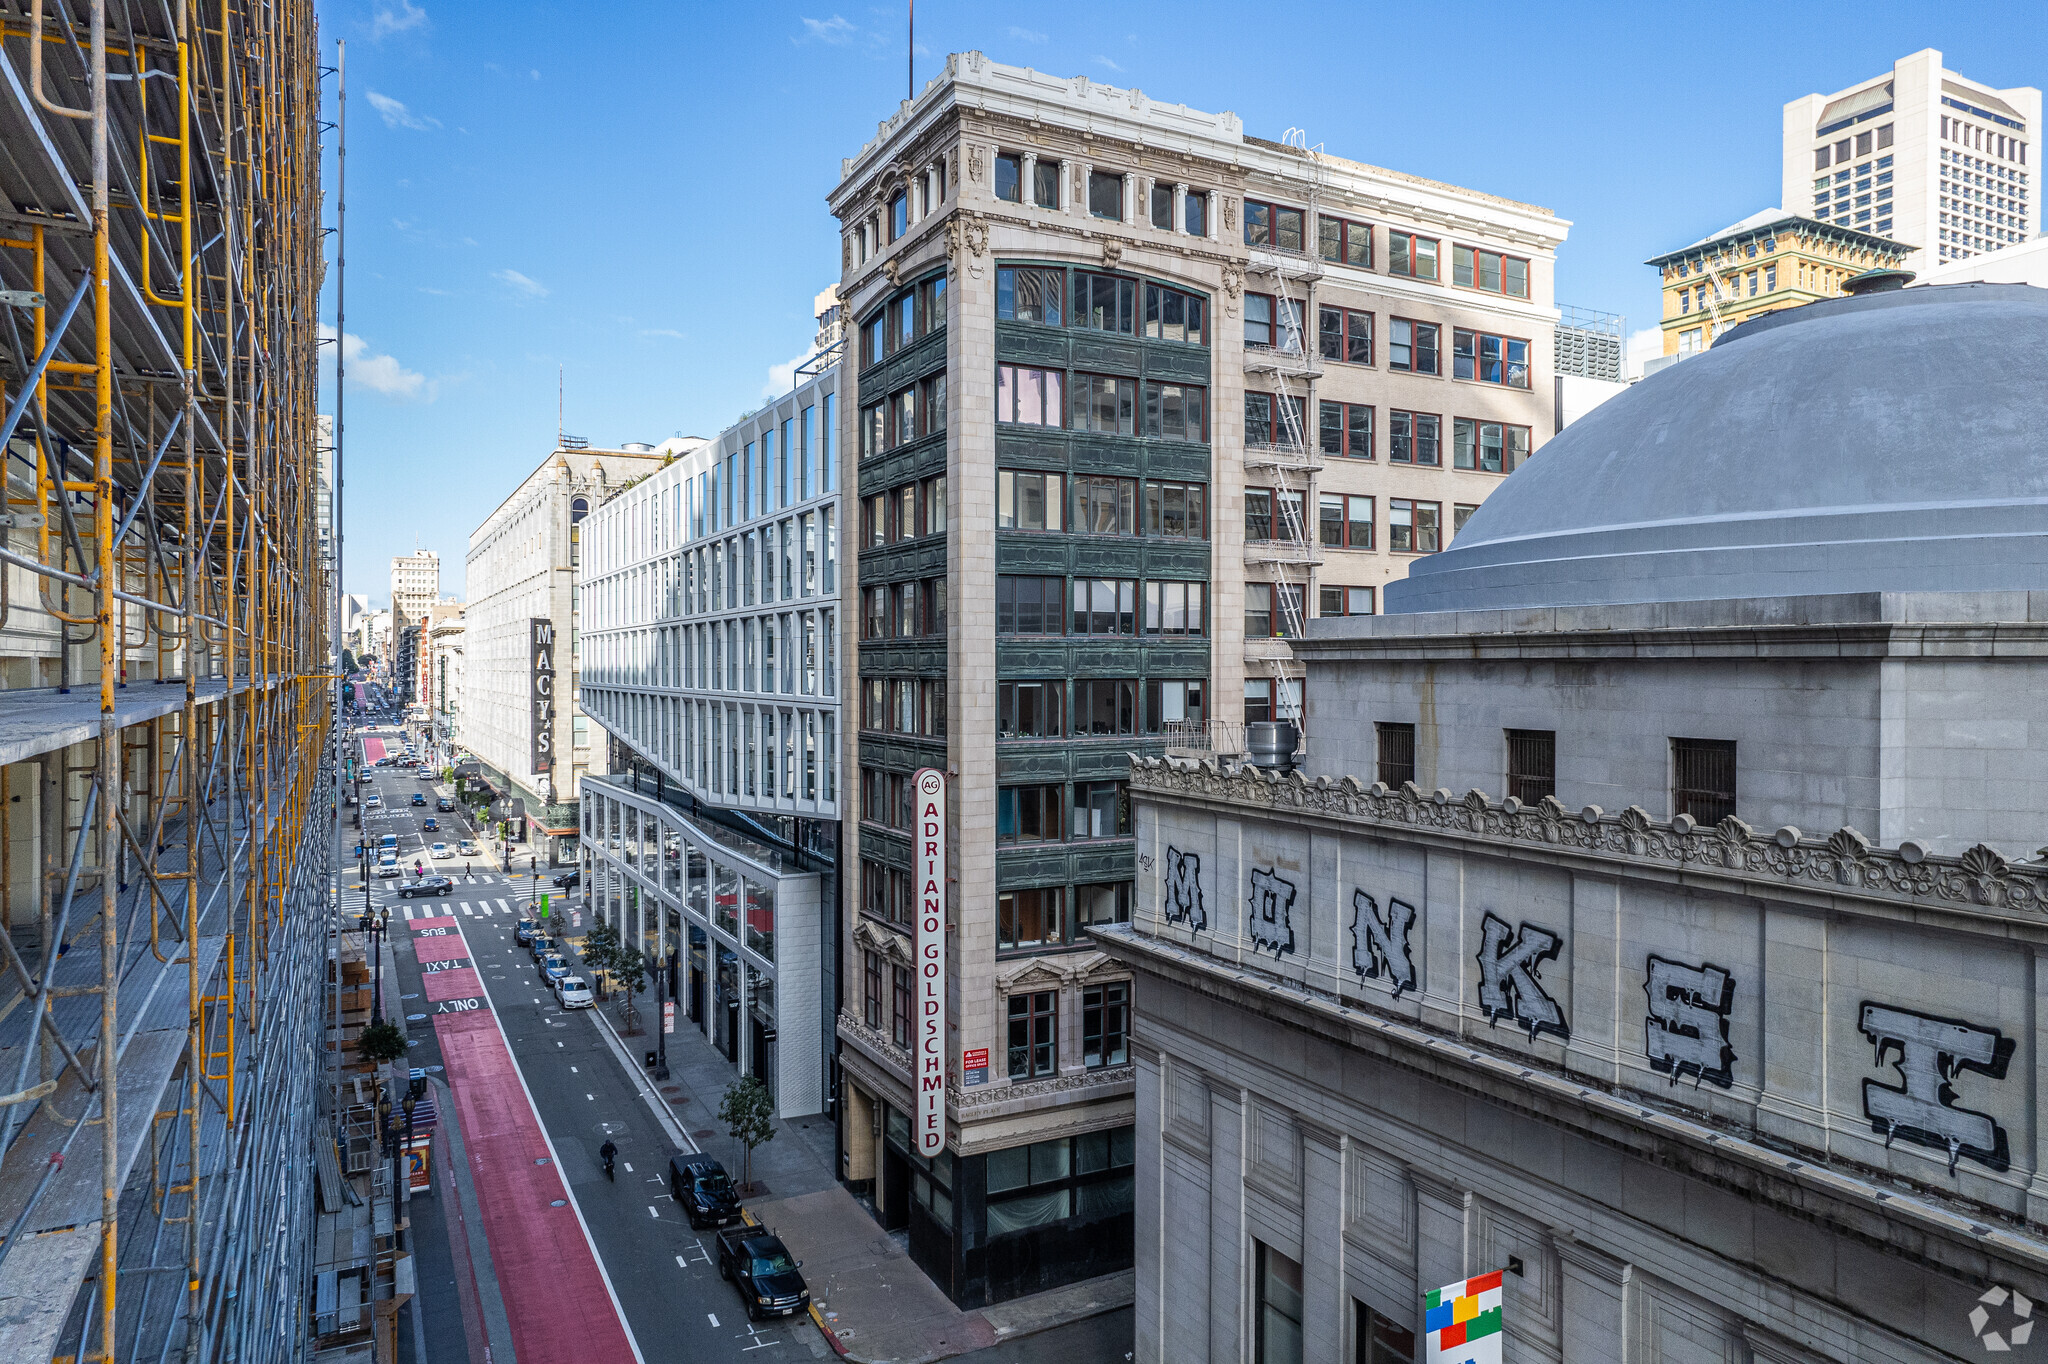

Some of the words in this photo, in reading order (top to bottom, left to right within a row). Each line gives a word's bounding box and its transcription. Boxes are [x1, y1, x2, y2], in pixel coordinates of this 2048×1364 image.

[924, 781, 938, 789] AG
[924, 802, 939, 933] ADRIANO
[421, 927, 447, 937] BUS
[426, 959, 462, 972] TAXI
[438, 998, 479, 1013] ONLY
[922, 943, 942, 1149] GOLDSCHMIED
